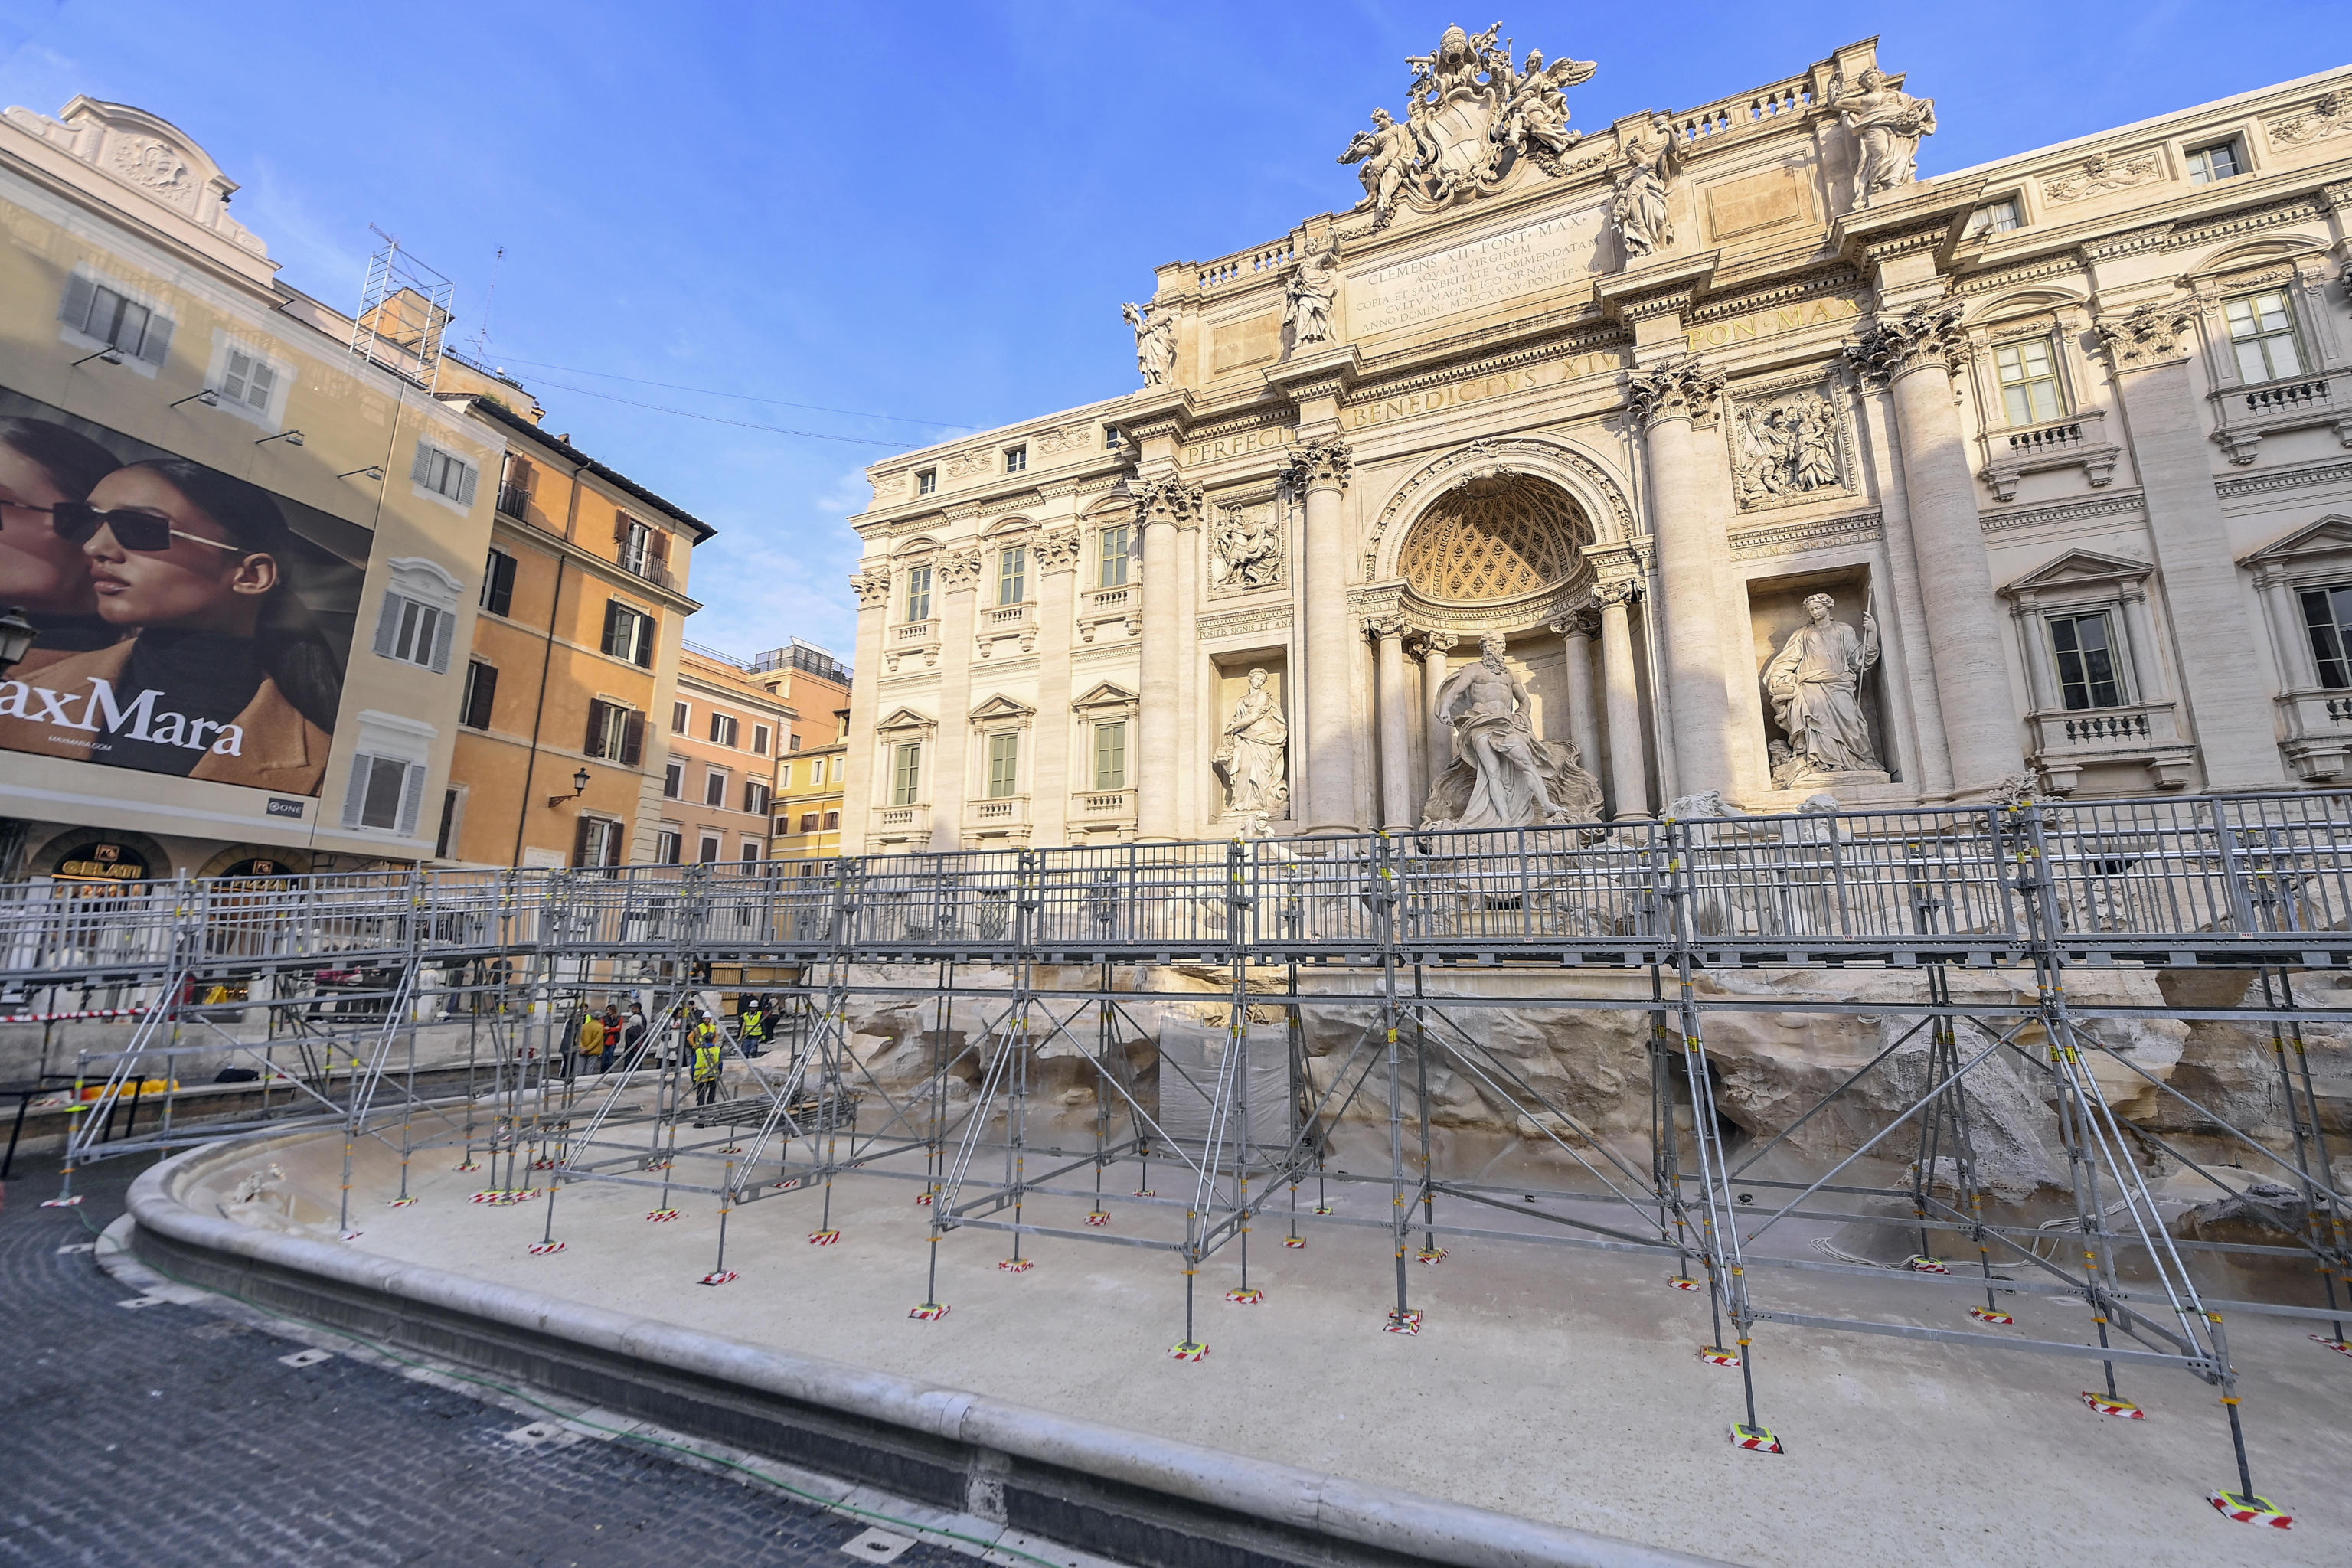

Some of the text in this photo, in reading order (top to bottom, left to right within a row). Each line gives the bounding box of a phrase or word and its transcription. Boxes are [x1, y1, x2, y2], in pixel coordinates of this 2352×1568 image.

[1356, 237, 1600, 312] COPIA ET SALVBRITATE COMMENDATAM
[1368, 257, 1437, 285] CLEMENS
[1416, 244, 1530, 284] AQVAM VIRGINEM
[1386, 257, 1567, 314] CVLTV MAGNIFICO ORNAVIT
[1362, 316, 1396, 332] ANNO
[1400, 303, 1444, 322] DOMINI
[1353, 368, 1537, 428] BENEDICTVS
[62, 860, 143, 880] GELATI
